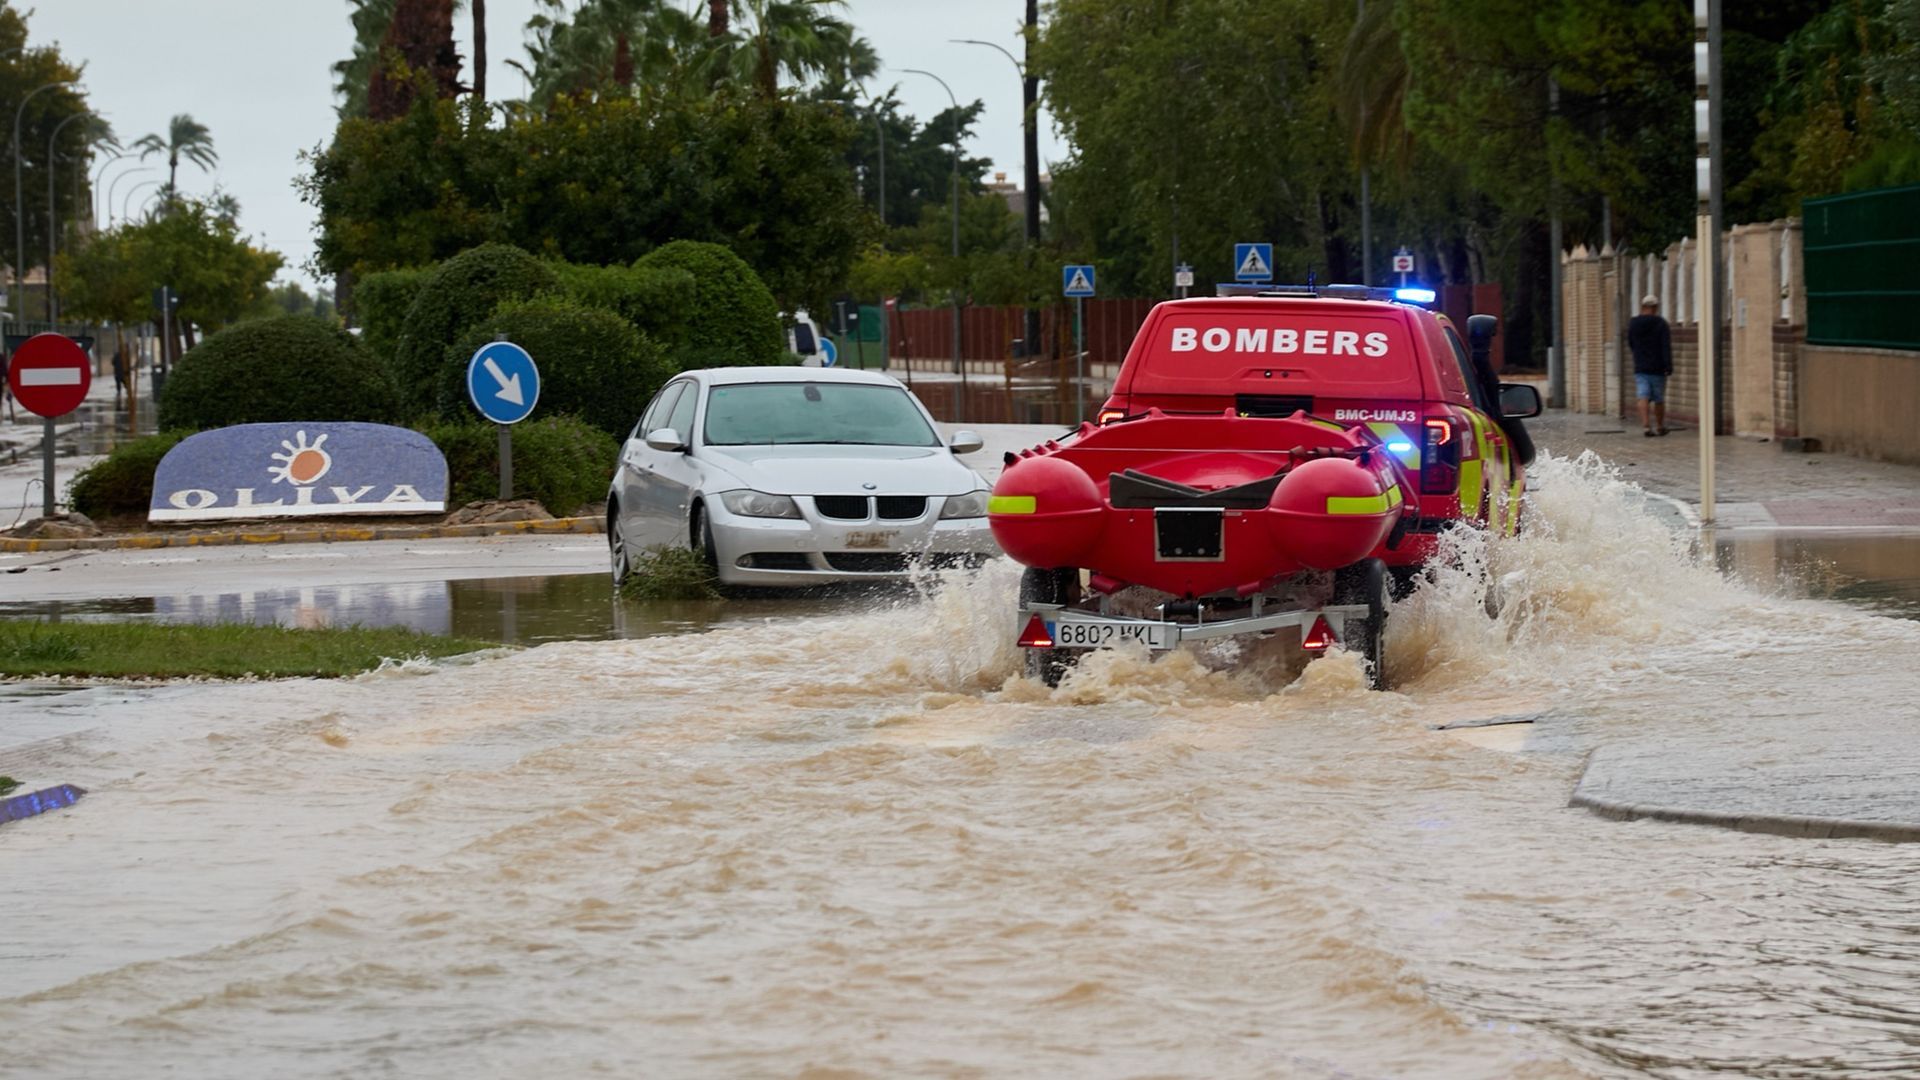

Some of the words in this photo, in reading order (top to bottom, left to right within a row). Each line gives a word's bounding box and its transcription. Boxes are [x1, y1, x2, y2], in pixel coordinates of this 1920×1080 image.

[1170, 327, 1389, 357] BOMBERS
[1335, 408, 1416, 422] BMC-UMJ3
[168, 484, 427, 510] OLIVA
[1060, 624, 1114, 644] 6802
